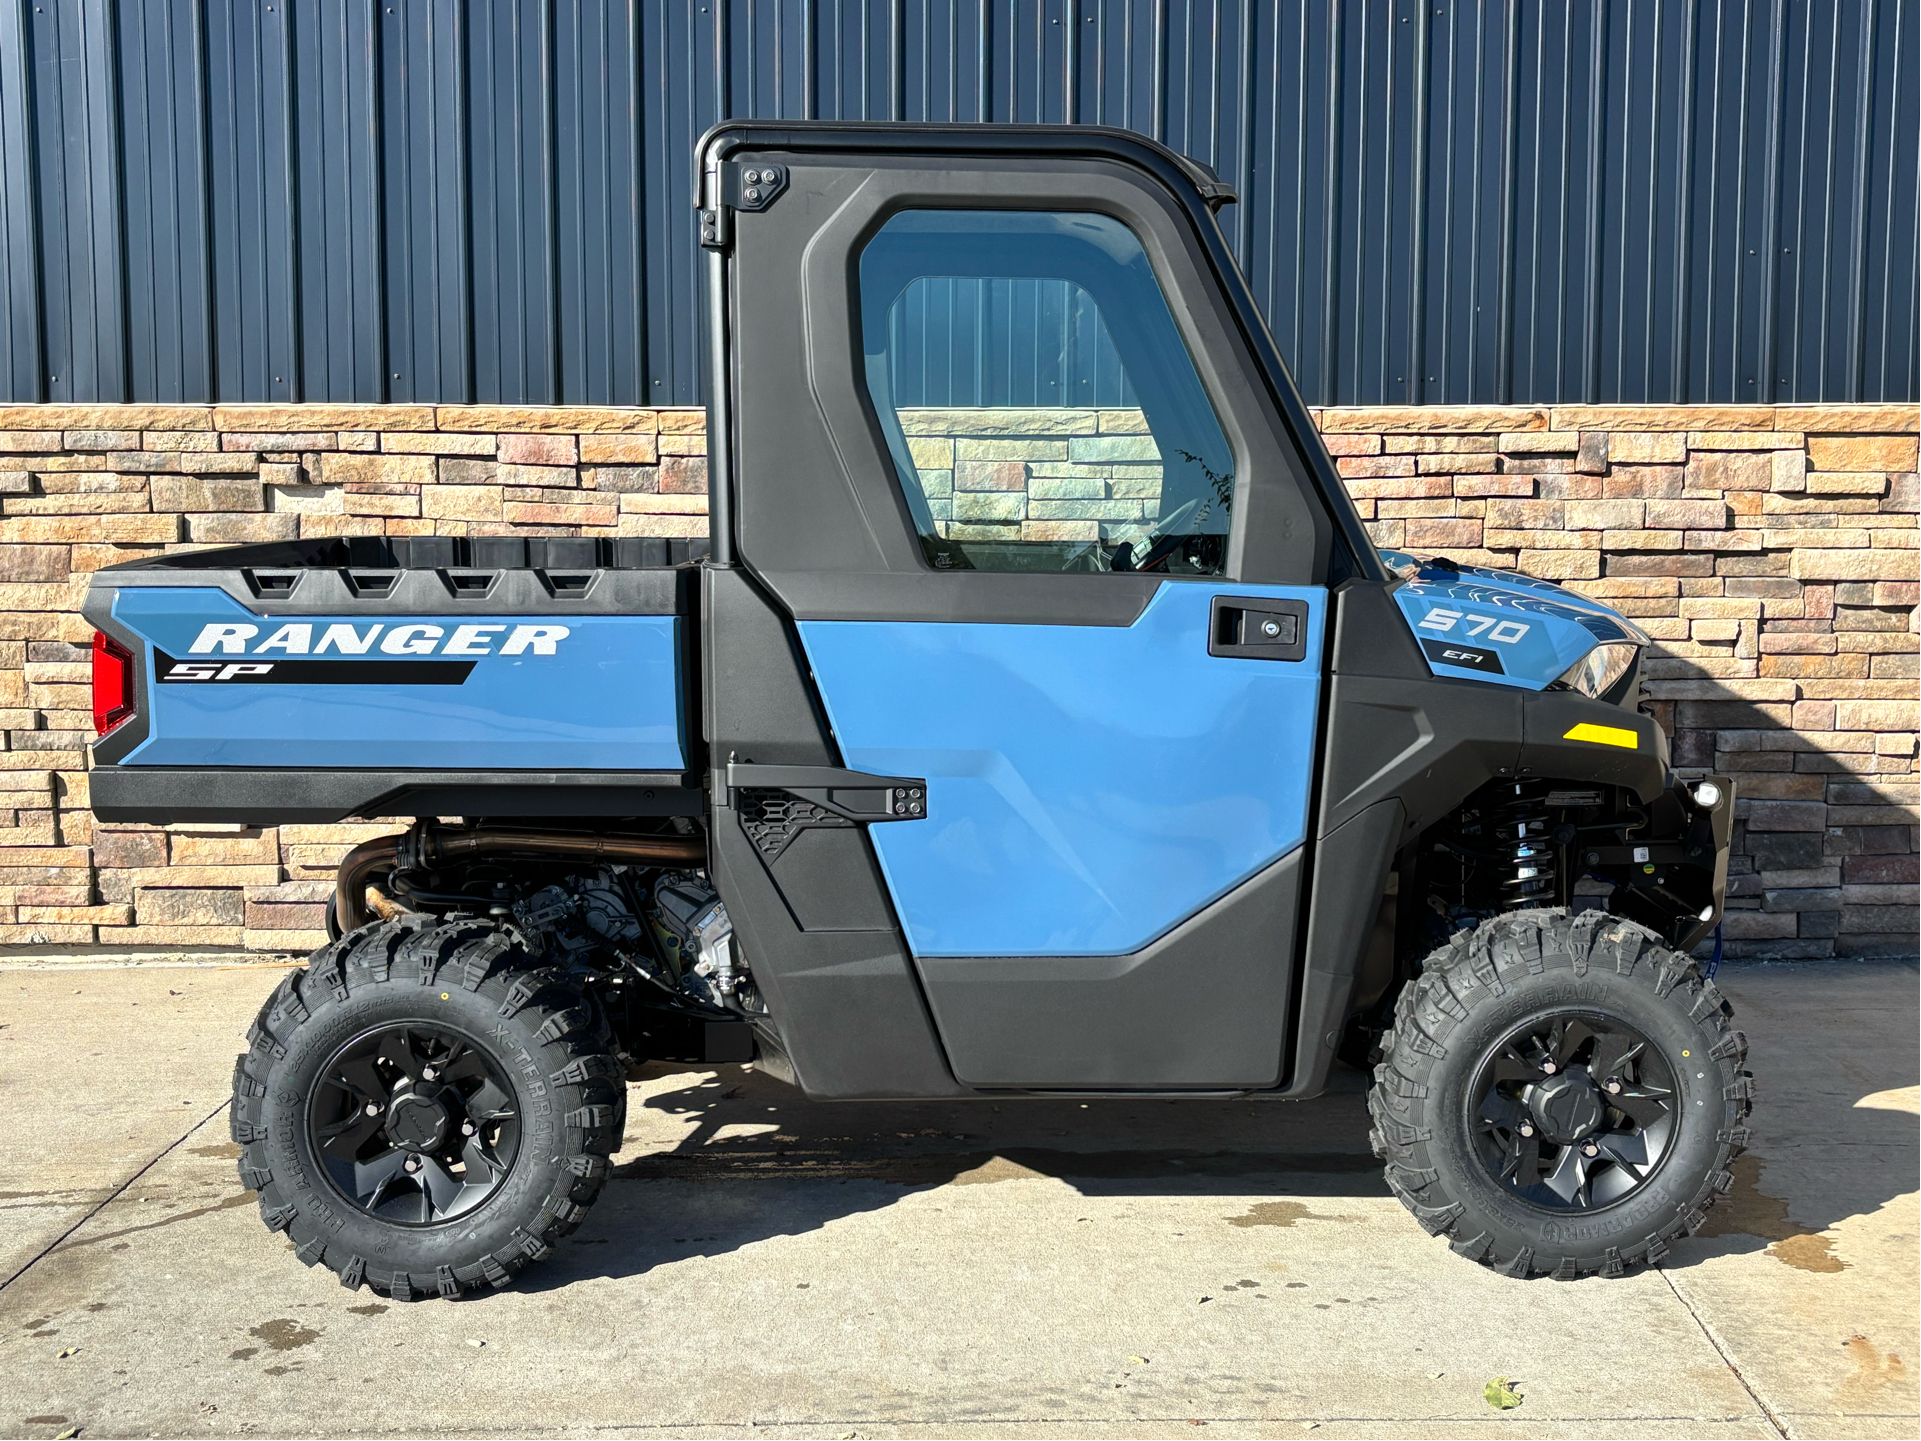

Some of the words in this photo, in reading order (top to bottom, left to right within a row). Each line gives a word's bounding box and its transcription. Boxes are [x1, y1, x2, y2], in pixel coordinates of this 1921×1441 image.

[187, 623, 571, 656] RANGER
[1417, 607, 1531, 644] 570
[163, 663, 275, 680] SP
[1442, 649, 1484, 663] EFI
[1465, 982, 1608, 1052] X-TERRAIN
[485, 1021, 555, 1164] X-TERRAIN
